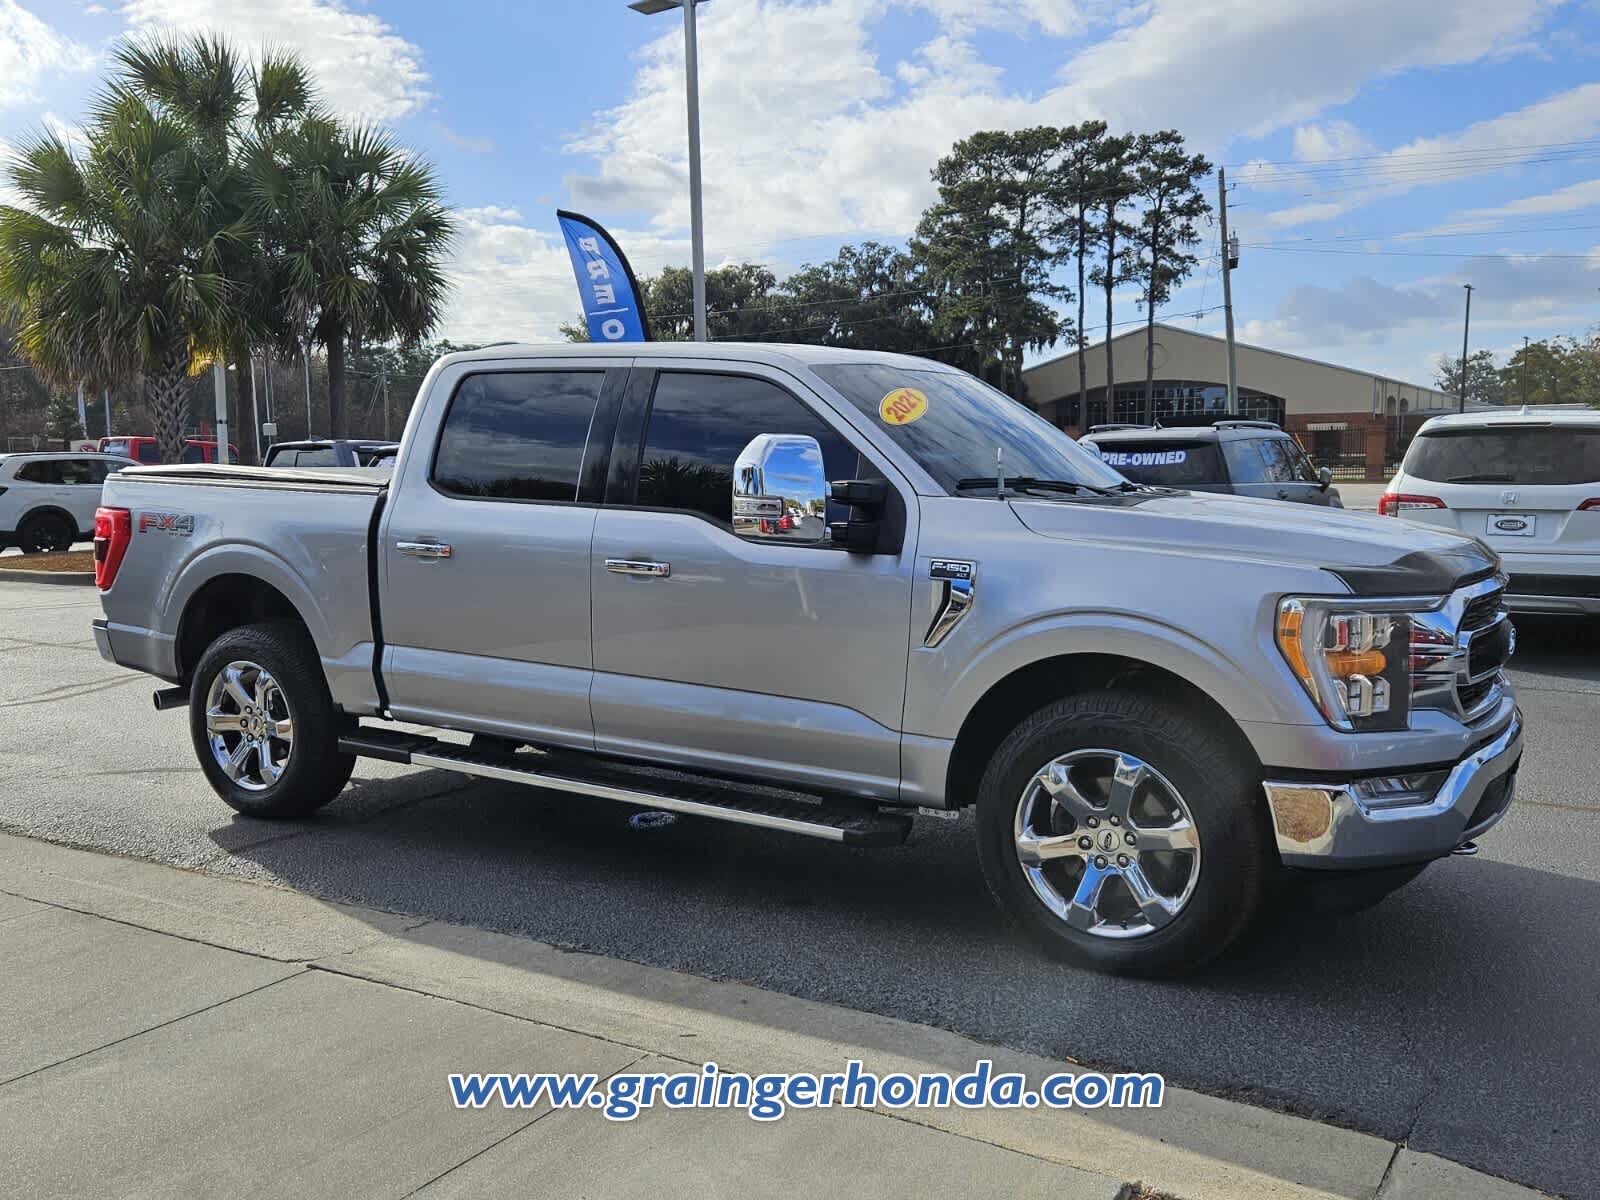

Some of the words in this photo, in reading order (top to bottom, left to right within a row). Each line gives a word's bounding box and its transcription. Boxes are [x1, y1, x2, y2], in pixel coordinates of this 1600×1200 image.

[1101, 450, 1187, 466] PRE-OWNED
[138, 511, 194, 533] FX4
[931, 562, 970, 573] F-150
